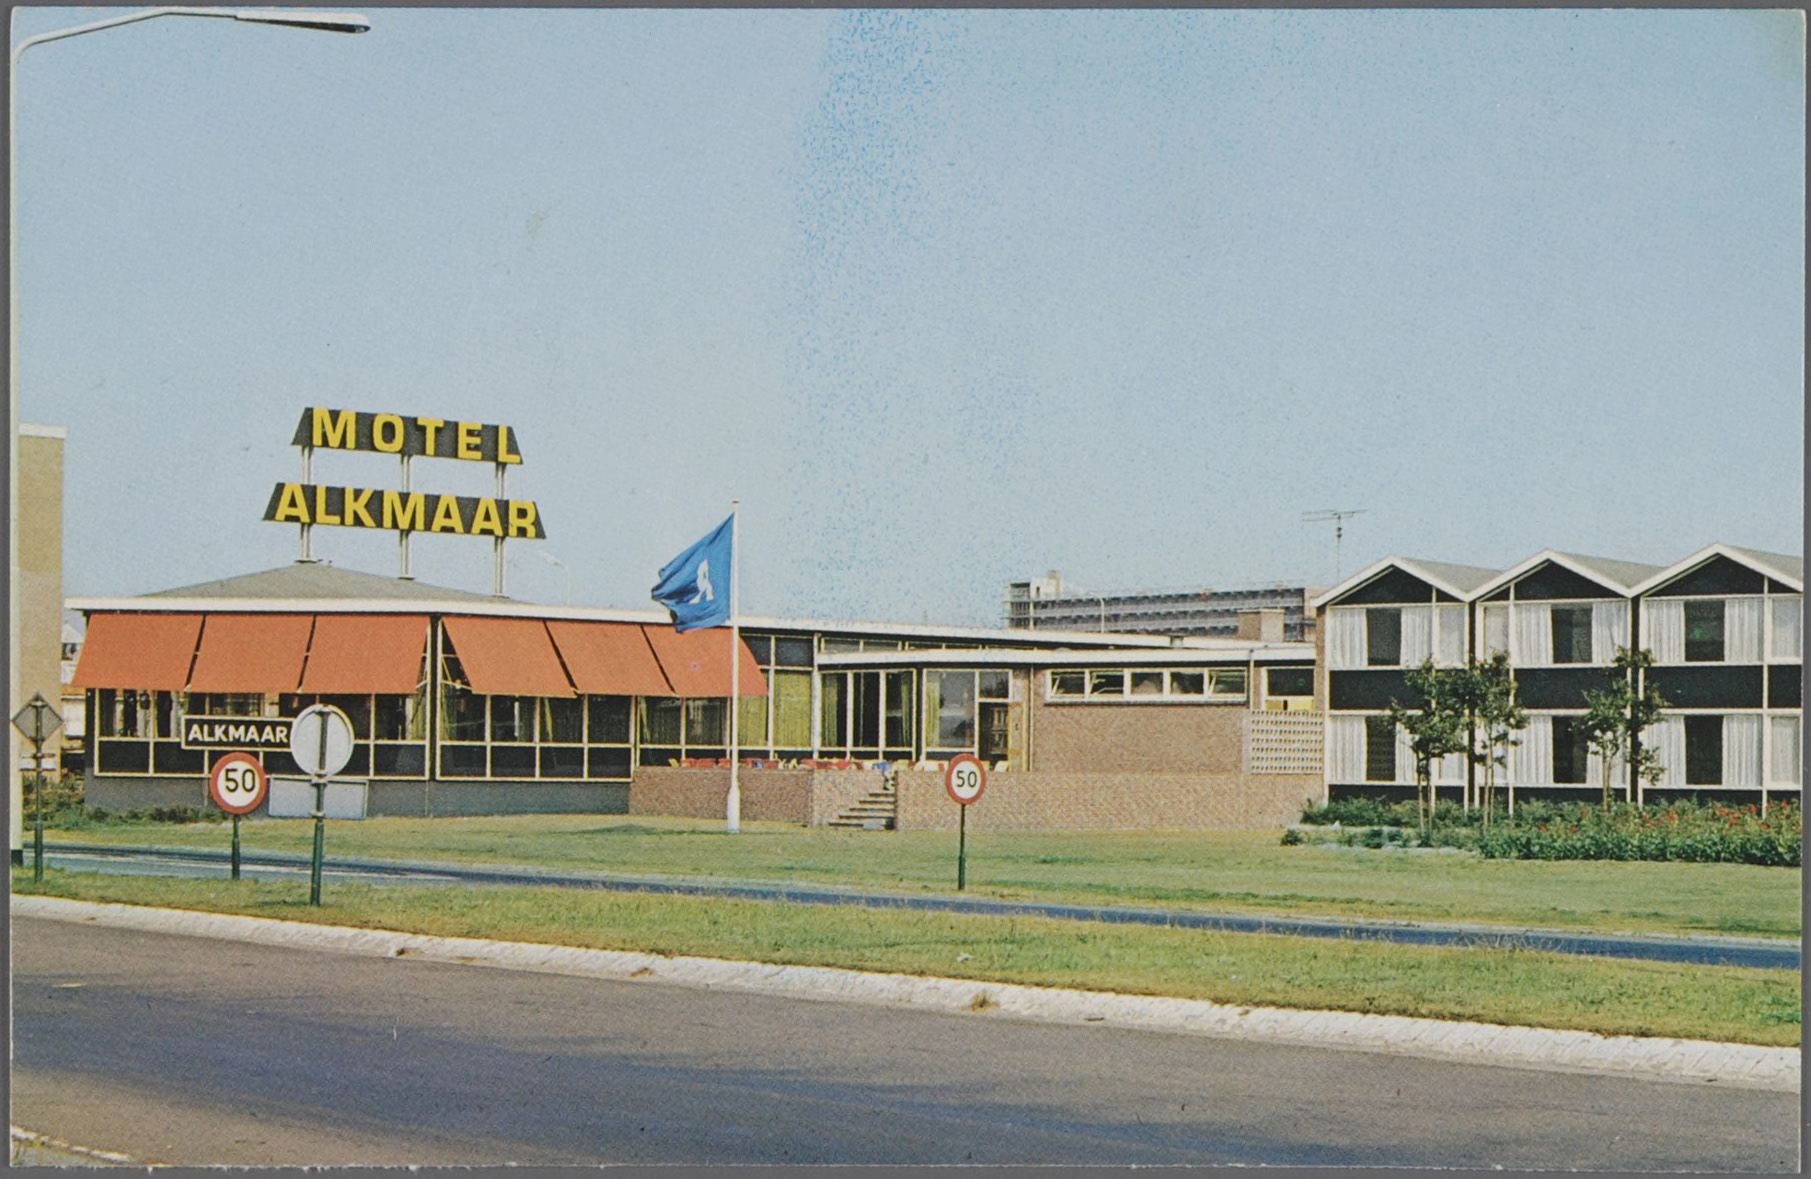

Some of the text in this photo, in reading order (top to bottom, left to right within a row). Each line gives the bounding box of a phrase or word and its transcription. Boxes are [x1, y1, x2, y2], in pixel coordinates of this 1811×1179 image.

[312, 407, 521, 463] MOTEL
[275, 483, 536, 538] ALKMAAR
[187, 724, 288, 743] ALKMAAR
[224, 768, 256, 793] 50
[956, 770, 978, 789] 50
